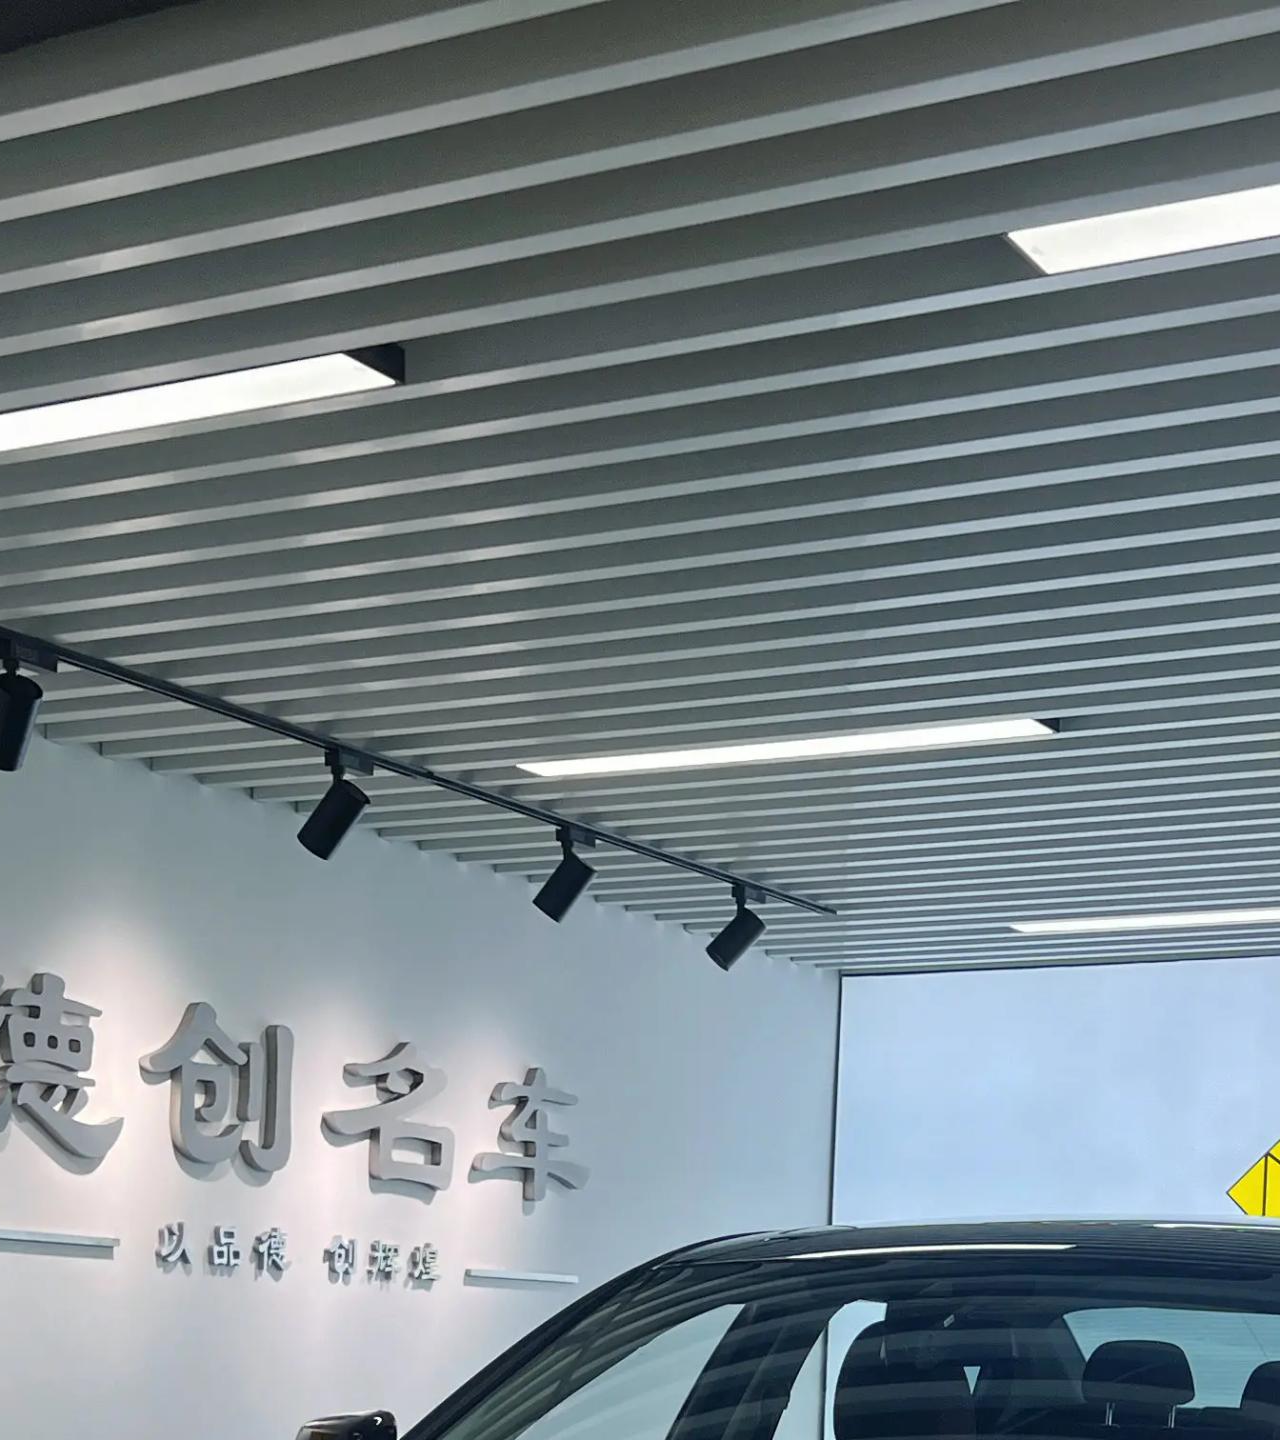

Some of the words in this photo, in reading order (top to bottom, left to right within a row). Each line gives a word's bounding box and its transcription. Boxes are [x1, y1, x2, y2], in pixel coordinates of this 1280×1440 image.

[156, 1222, 289, 1274] 以品德
[325, 1235, 441, 1285] 创辉煌
